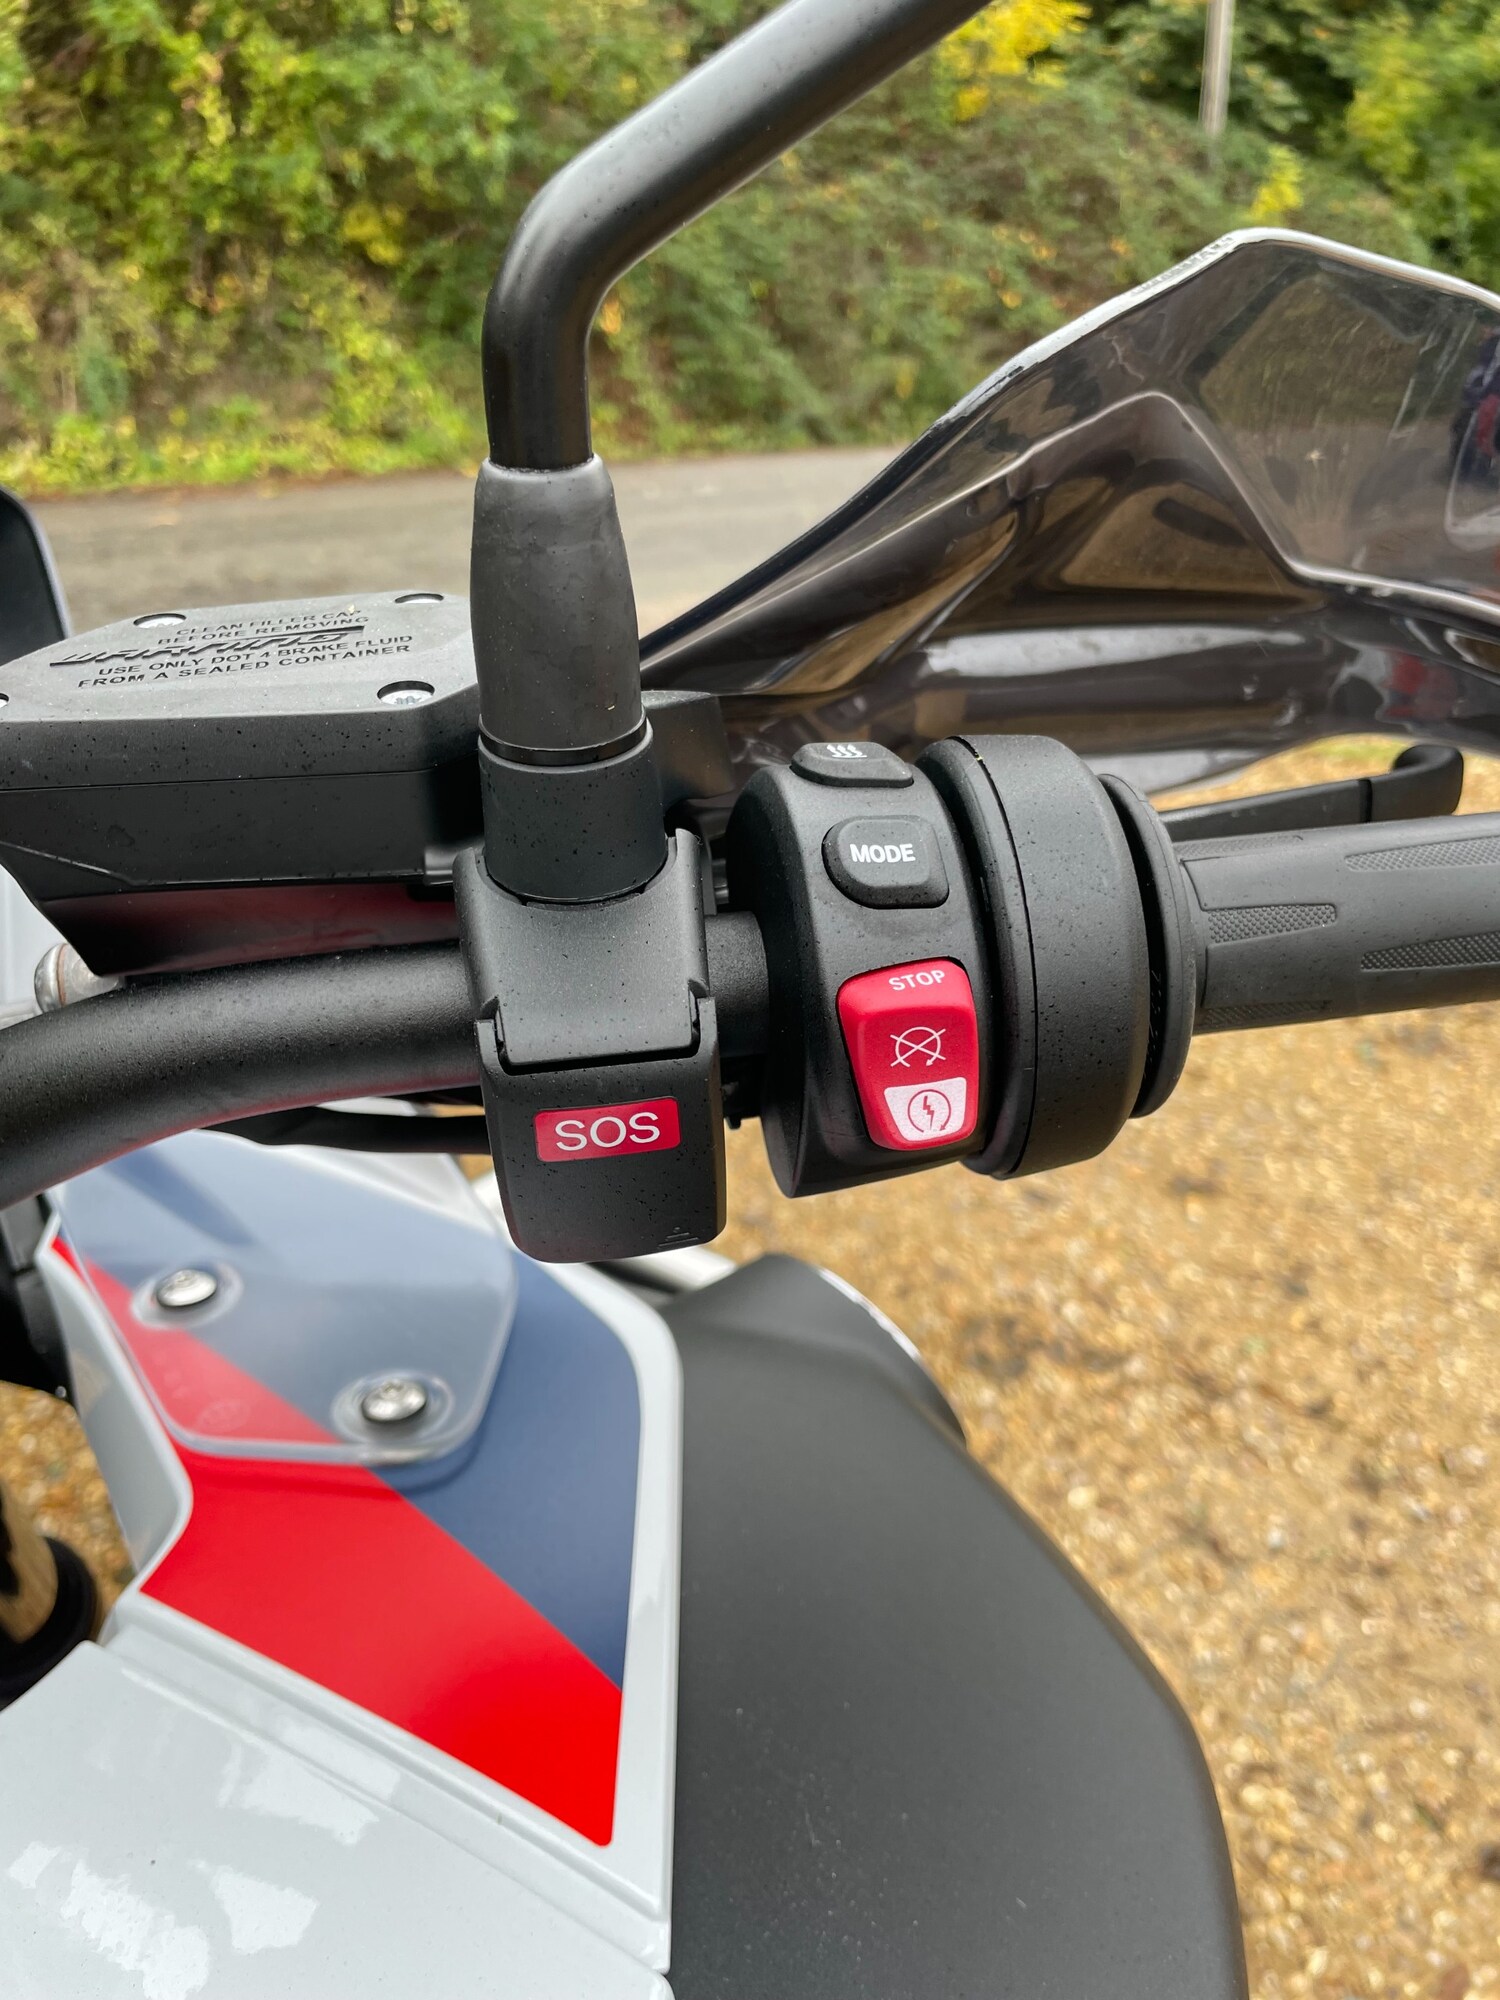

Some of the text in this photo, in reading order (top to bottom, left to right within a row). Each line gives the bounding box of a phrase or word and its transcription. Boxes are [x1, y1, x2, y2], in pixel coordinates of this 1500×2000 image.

[158, 616, 369, 645] BEFORE REMOVING
[78, 644, 411, 688] FROM A SEALED CONTAINER
[99, 635, 413, 676] USE ONLY DOT 4 BRAKE FLUID
[849, 843, 916, 863] MODE
[888, 969, 946, 991] STOP
[554, 1111, 661, 1151] SOS
